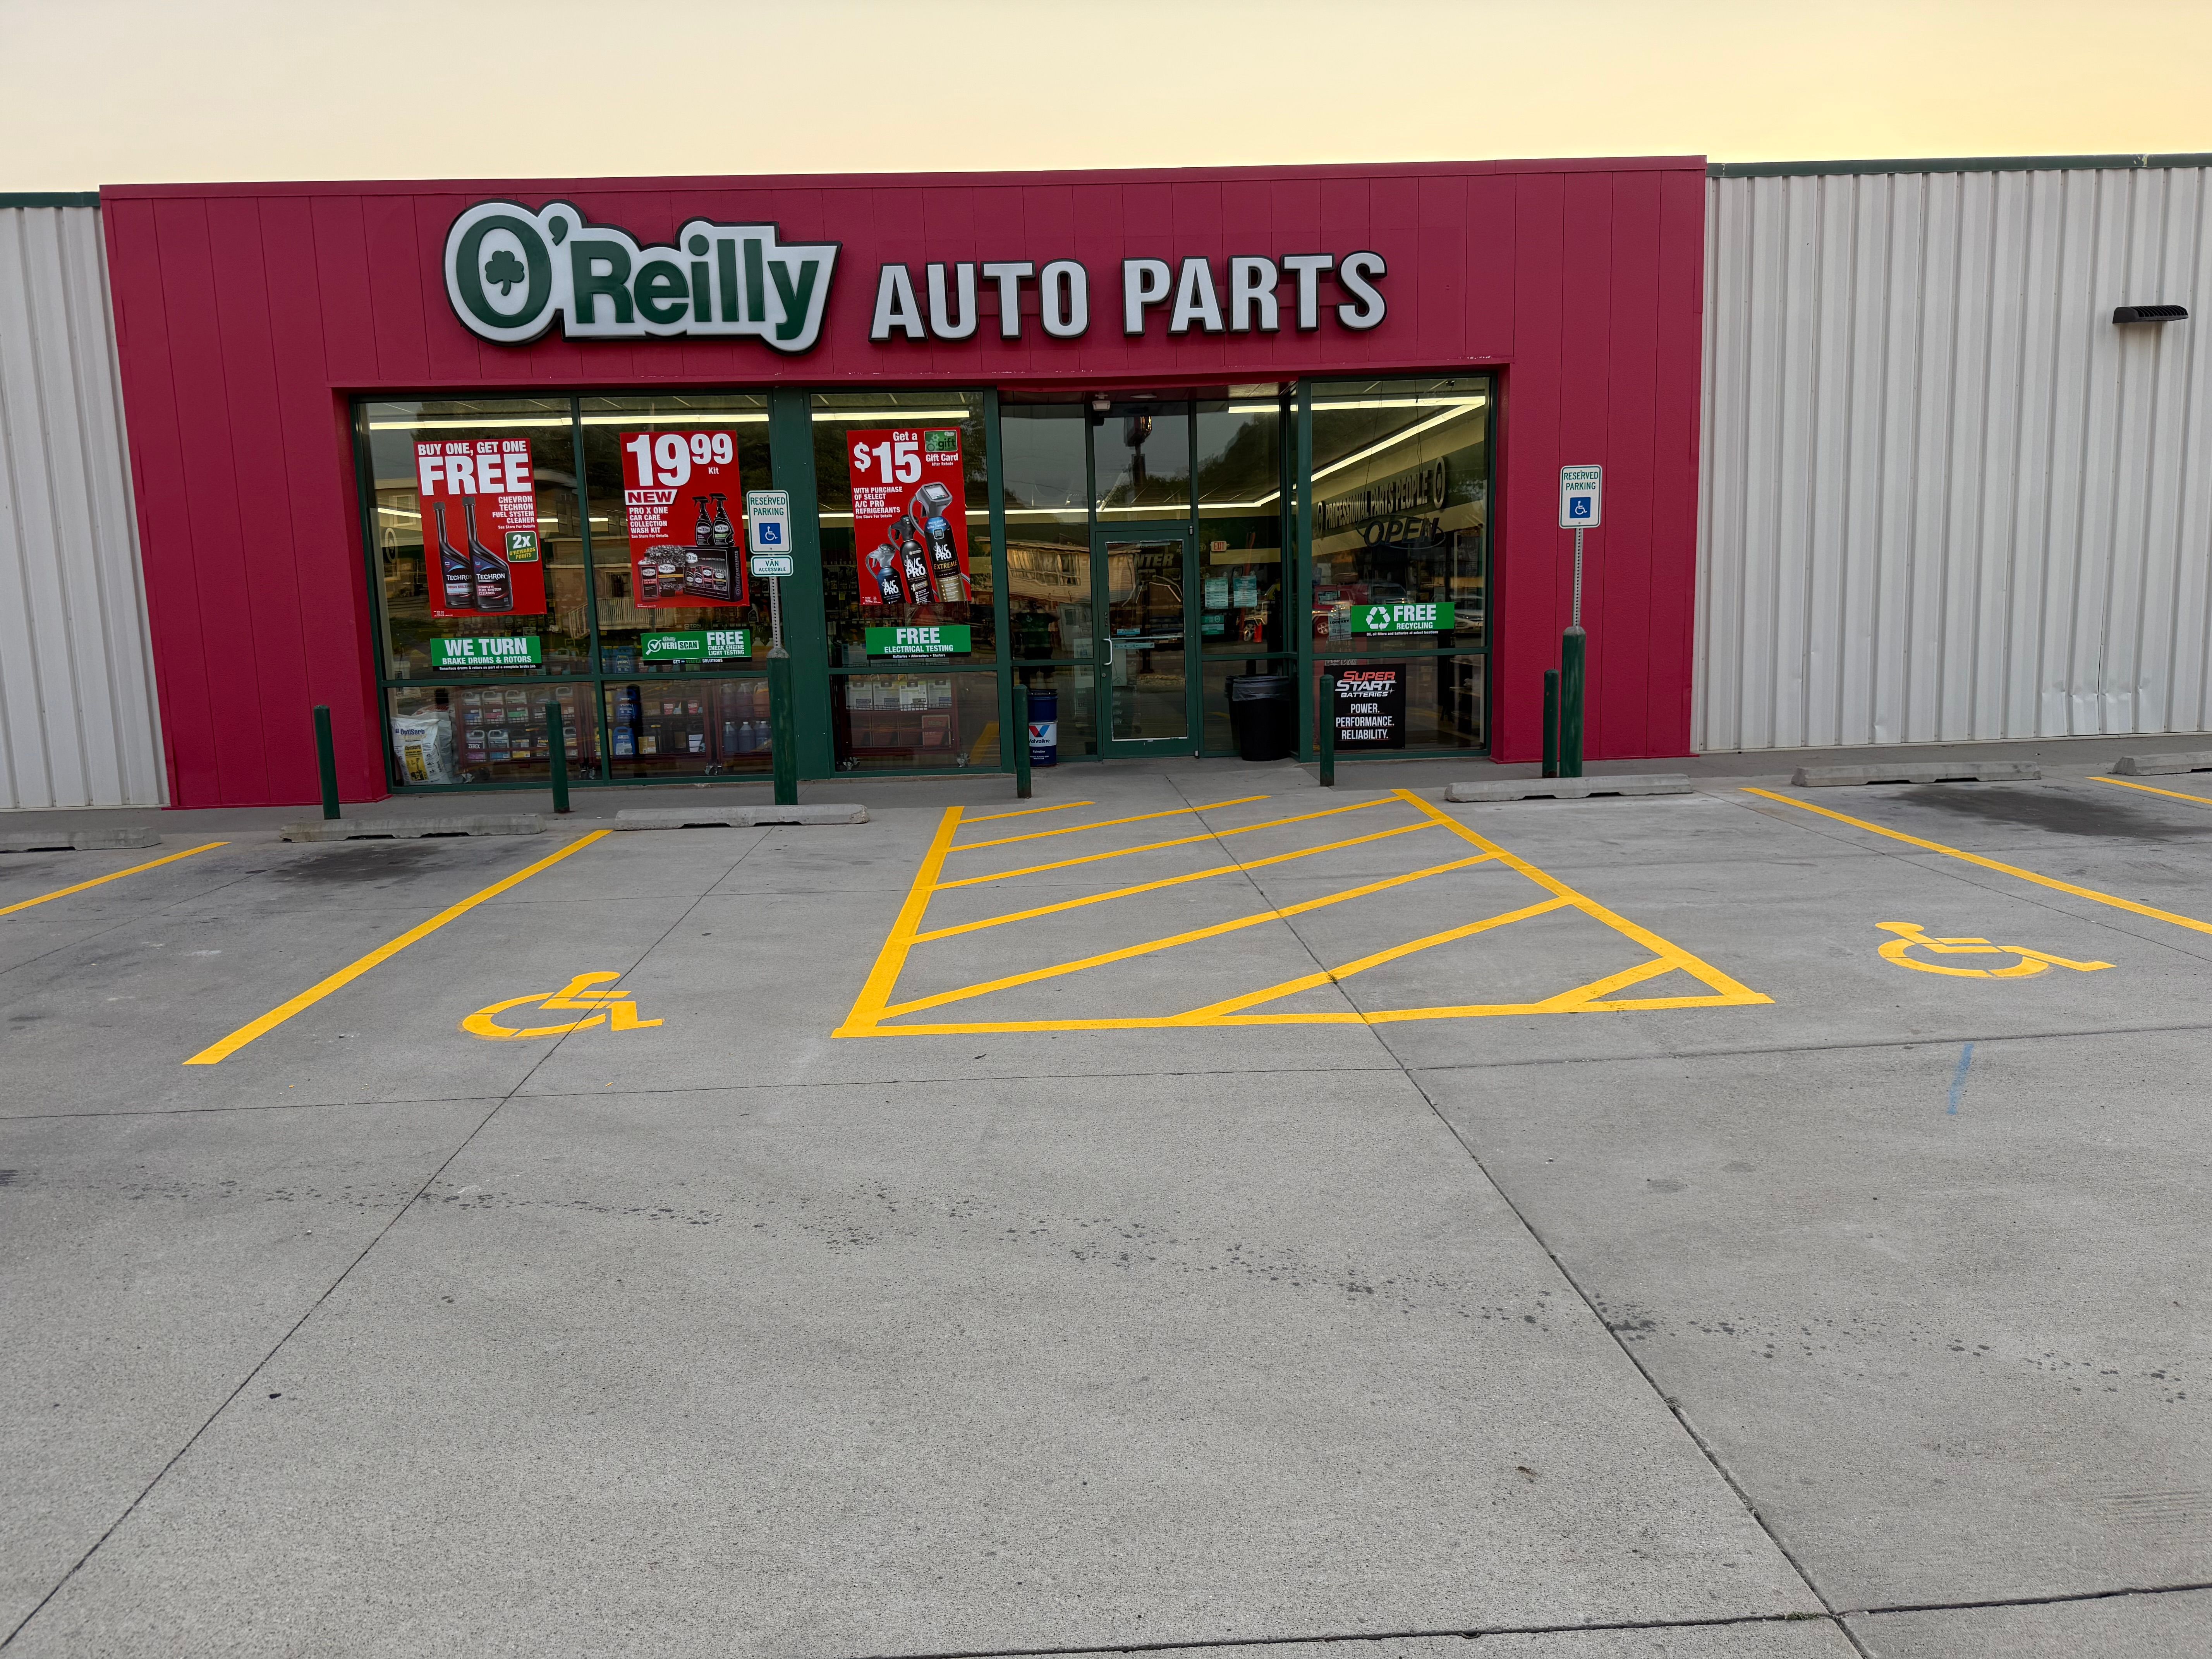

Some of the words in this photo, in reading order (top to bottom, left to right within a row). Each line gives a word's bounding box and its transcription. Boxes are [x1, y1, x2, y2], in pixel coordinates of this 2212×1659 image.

[449, 205, 836, 349] O'Reilly
[869, 259, 1090, 341] AUTO
[1123, 251, 1388, 335] PARTS
[893, 431, 909, 442] Get
[418, 444, 441, 455] BUY
[446, 443, 474, 456] ONE,
[477, 442, 498, 453] GET
[503, 441, 526, 452] ONE
[938, 438, 956, 451] gift
[854, 441, 922, 483] $15
[926, 454, 939, 462] Gift
[941, 453, 958, 462] Card
[419, 453, 532, 495] FREE
[1564, 472, 1599, 481] RESERVED
[1566, 482, 1596, 491] PARKING
[628, 491, 673, 503] NEW
[750, 497, 785, 505] RESERVED
[1325, 491, 1369, 530] PROFESSIONAL
[1370, 481, 1394, 517] PARTS
[1396, 470, 1428, 512] PEOPLE
[754, 508, 784, 516] PARKING
[1364, 517, 1440, 547] OPEN
[513, 534, 531, 549] 2x
[1214, 542, 1224, 551] EXIT
[936, 543, 949, 553] A/C
[935, 551, 952, 561] PRO
[907, 556, 923, 569] A/C
[934, 561, 958, 570] EXTREME
[906, 566, 926, 578] PRO
[884, 579, 896, 588] A/C
[883, 586, 899, 595] PRO
[1394, 604, 1436, 622] FREE
[706, 631, 744, 646] FREE
[896, 627, 940, 645] FREE
[445, 639, 474, 656] WE
[478, 638, 527, 655] TURN
[1342, 671, 1395, 681] SUPER
[1335, 680, 1395, 692] START
[1350, 703, 1380, 713] POWER.
[1336, 716, 1395, 727] PERFORMANCE.
[1341, 729, 1388, 740] RELIABILITY.
